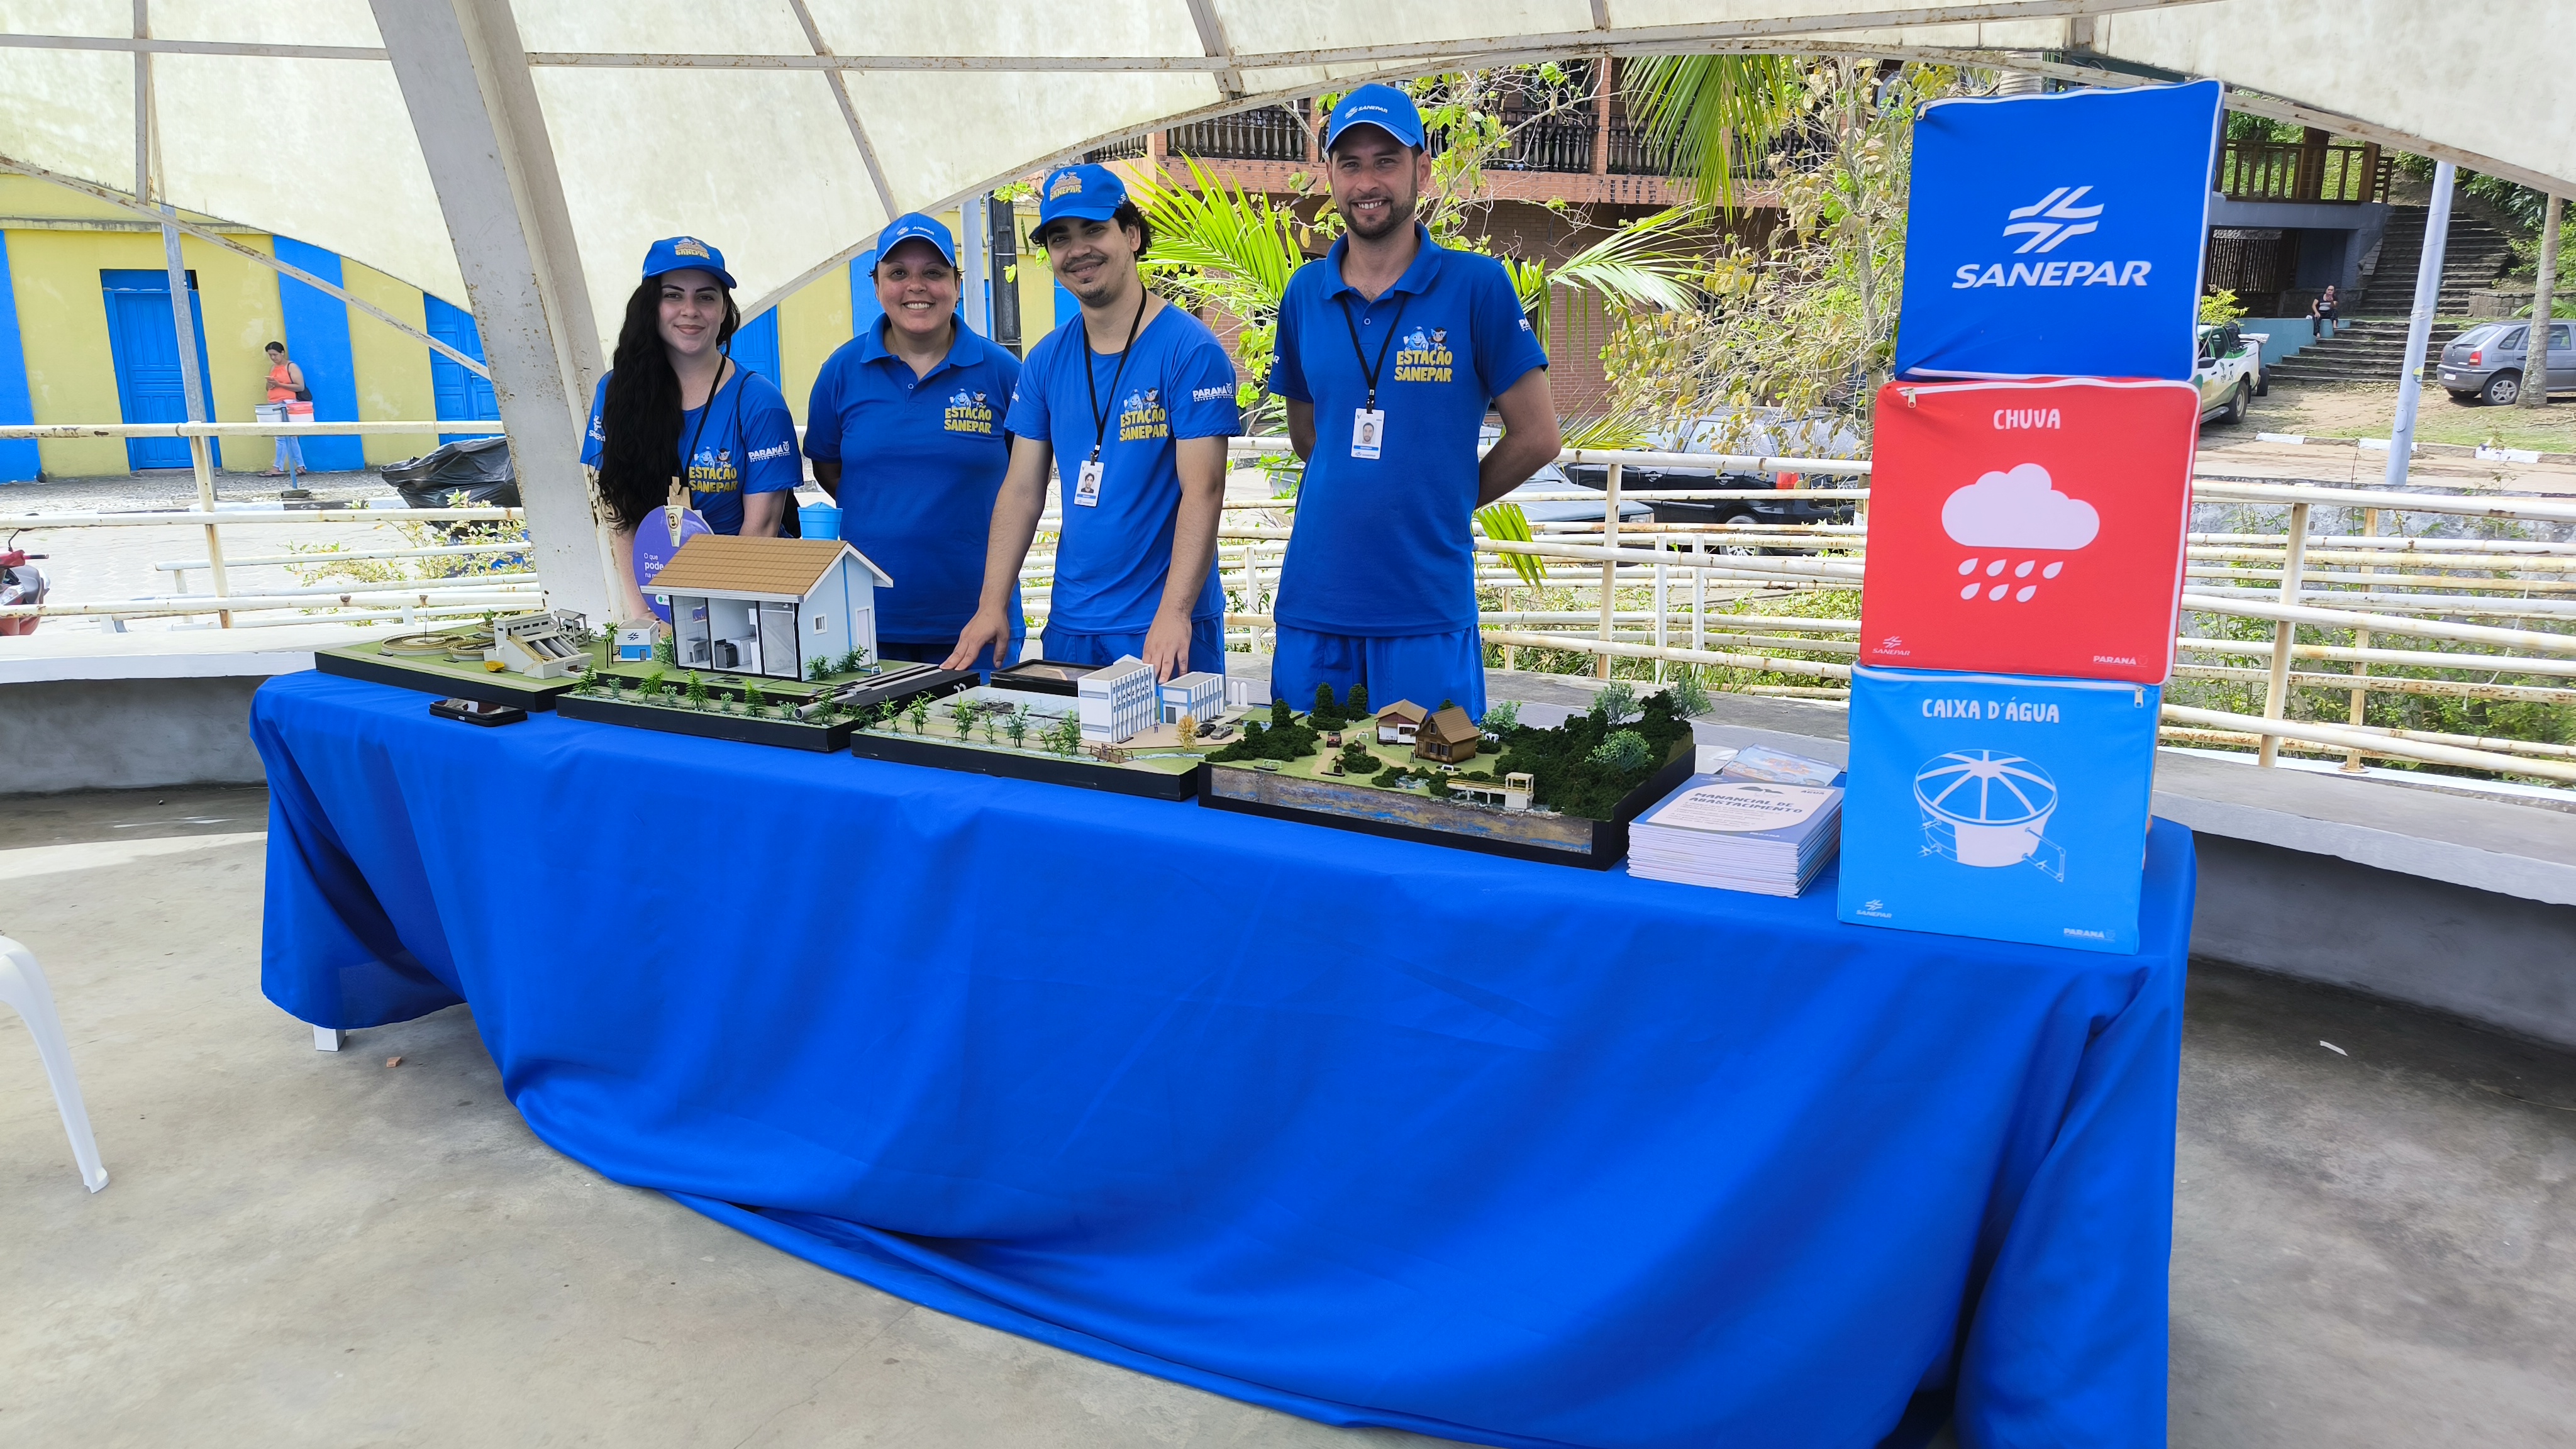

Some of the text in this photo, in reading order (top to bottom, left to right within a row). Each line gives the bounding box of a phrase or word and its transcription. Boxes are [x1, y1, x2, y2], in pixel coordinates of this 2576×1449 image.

[1050, 185, 1082, 201] SANEPAR
[1951, 260, 2152, 289] SANEPAR
[1396, 346, 1453, 366] ESTAÇÃO
[1394, 367, 1453, 382] SANEPAR
[945, 404, 992, 421] ESTAÇÃO
[1120, 404, 1166, 428] ESTAÇÃO
[1993, 408, 2060, 430] CHUVA
[944, 419, 992, 434] SANEPAR
[1119, 423, 1169, 441] SANEPAR
[589, 430, 606, 442] SANEPA
[689, 464, 737, 480] ESTAÇÃO
[689, 480, 738, 493] SANEPAR
[645, 561, 664, 571] pode
[1872, 648, 1911, 656] SANEPAR
[2093, 655, 2136, 665] PARANÁ
[1922, 698, 1980, 719] CAIXA
[1694, 792, 1771, 805] MANANCIAL
[1856, 909, 1892, 918] SANEPAR
